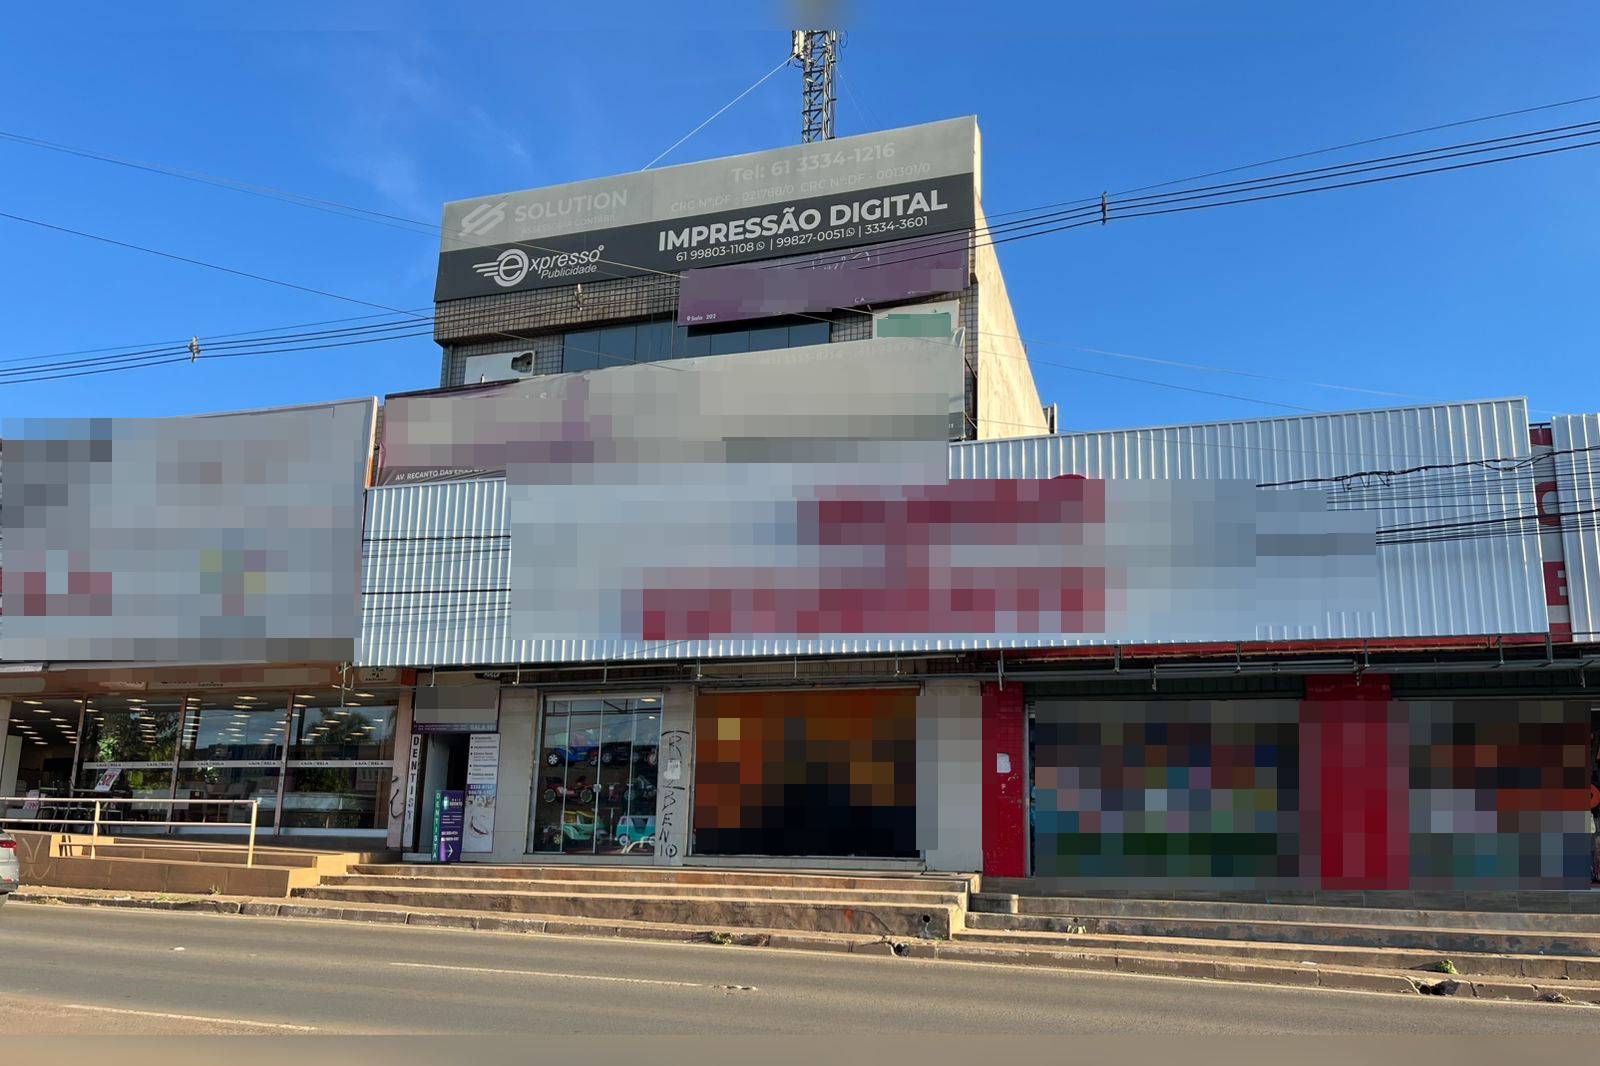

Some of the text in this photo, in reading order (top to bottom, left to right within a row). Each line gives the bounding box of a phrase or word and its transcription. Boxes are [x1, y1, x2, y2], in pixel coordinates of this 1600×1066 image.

[730, 142, 896, 183] Tel: 61 3334-1216
[514, 189, 628, 222] SOLUTION
[658, 190, 948, 251] IMPRESSÃO DIGITAL
[676, 251, 688, 262] 61
[690, 242, 754, 260] 99803-1108
[776, 229, 845, 248] 99827-0051
[865, 216, 928, 235] 3334-3601
[540, 264, 598, 280] Publicidade
[406, 470, 438, 480] RECANTO
[432, 792, 441, 858] DENTISTA
